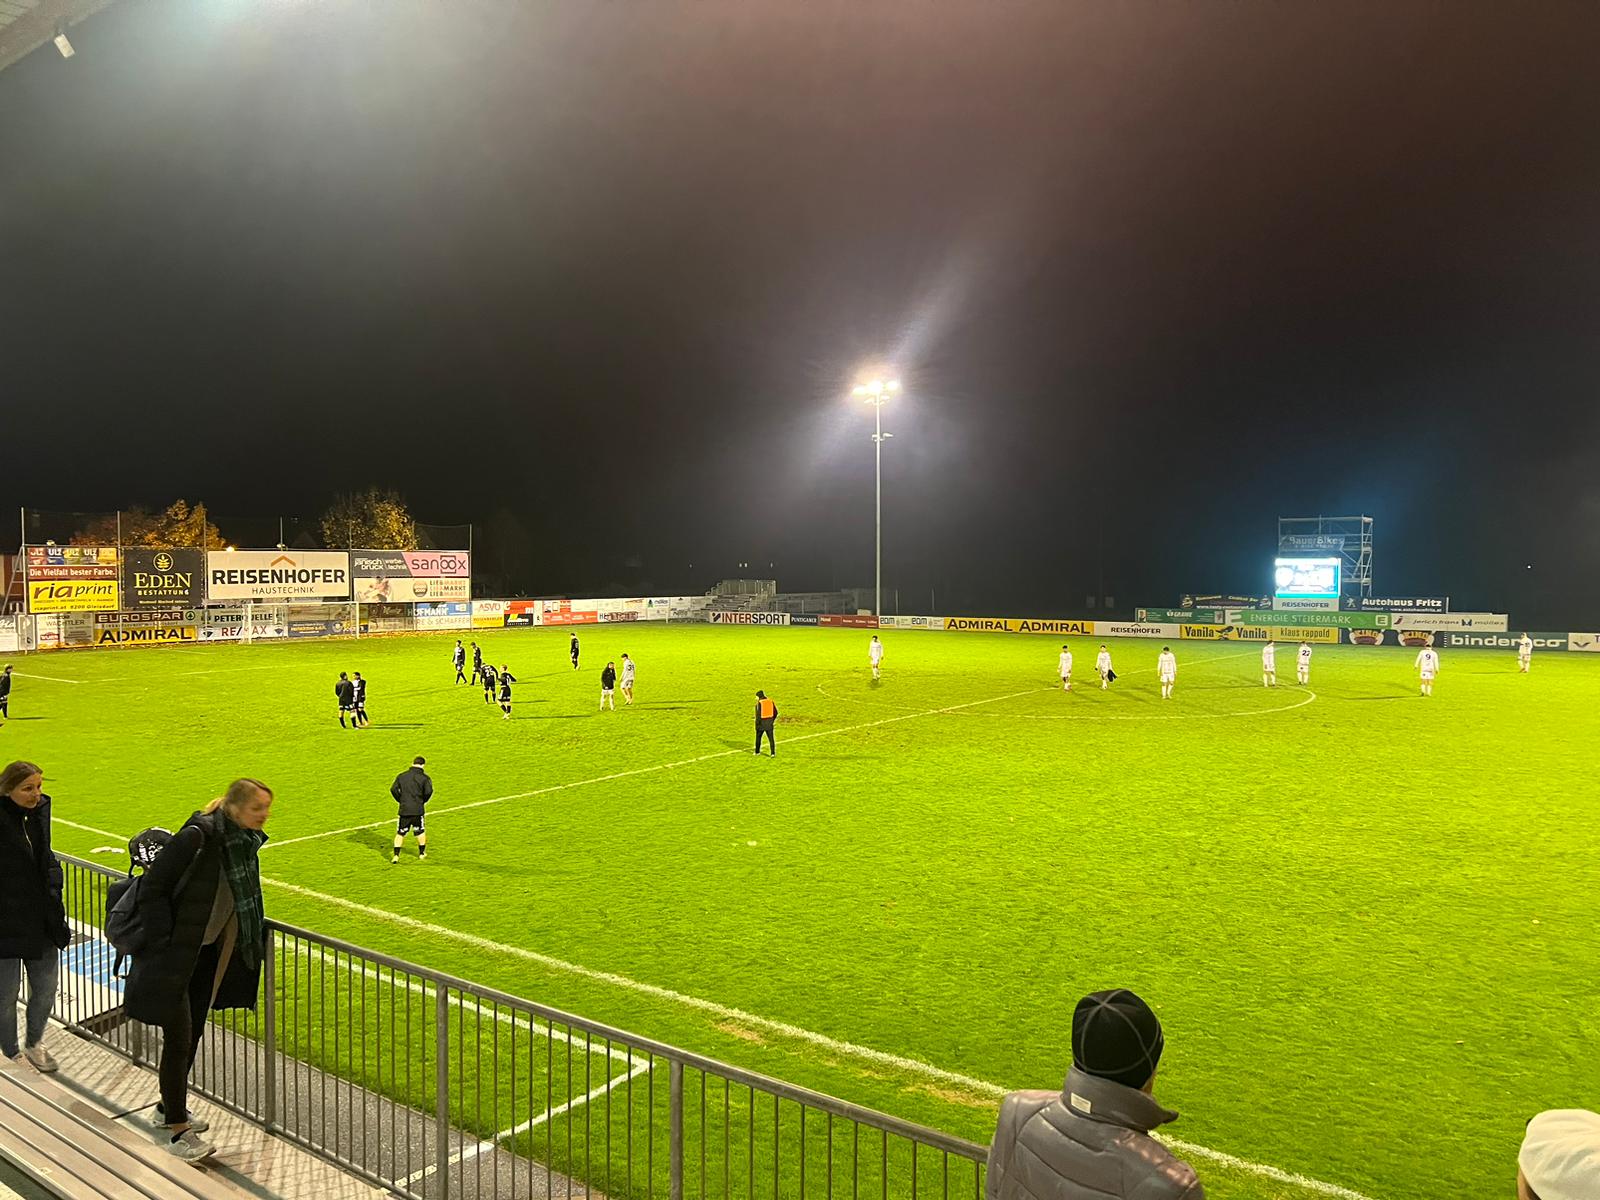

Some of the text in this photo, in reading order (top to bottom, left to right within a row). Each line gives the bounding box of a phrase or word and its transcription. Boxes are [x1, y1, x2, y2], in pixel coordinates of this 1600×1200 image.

[30, 567, 117, 577] Die Vielfalt bester Farbe.
[212, 569, 345, 585] REISENHOFER
[251, 586, 315, 595] HAUSTECHNIK
[1362, 598, 1442, 608] Autohaus Fritz
[98, 612, 182, 623] EUROSPAR
[721, 612, 787, 625] INTERSPORT
[1250, 613, 1289, 623] ENERGIE
[1292, 614, 1351, 624] STEIERMARK
[947, 618, 1014, 632] ADMIRAL
[1018, 620, 1091, 635] ADMIRAL
[99, 627, 193, 644] ADMIRAL
[1184, 626, 1215, 638] Vanila
[1236, 628, 1268, 640] Vanila
[1280, 627, 1299, 638] klaus
